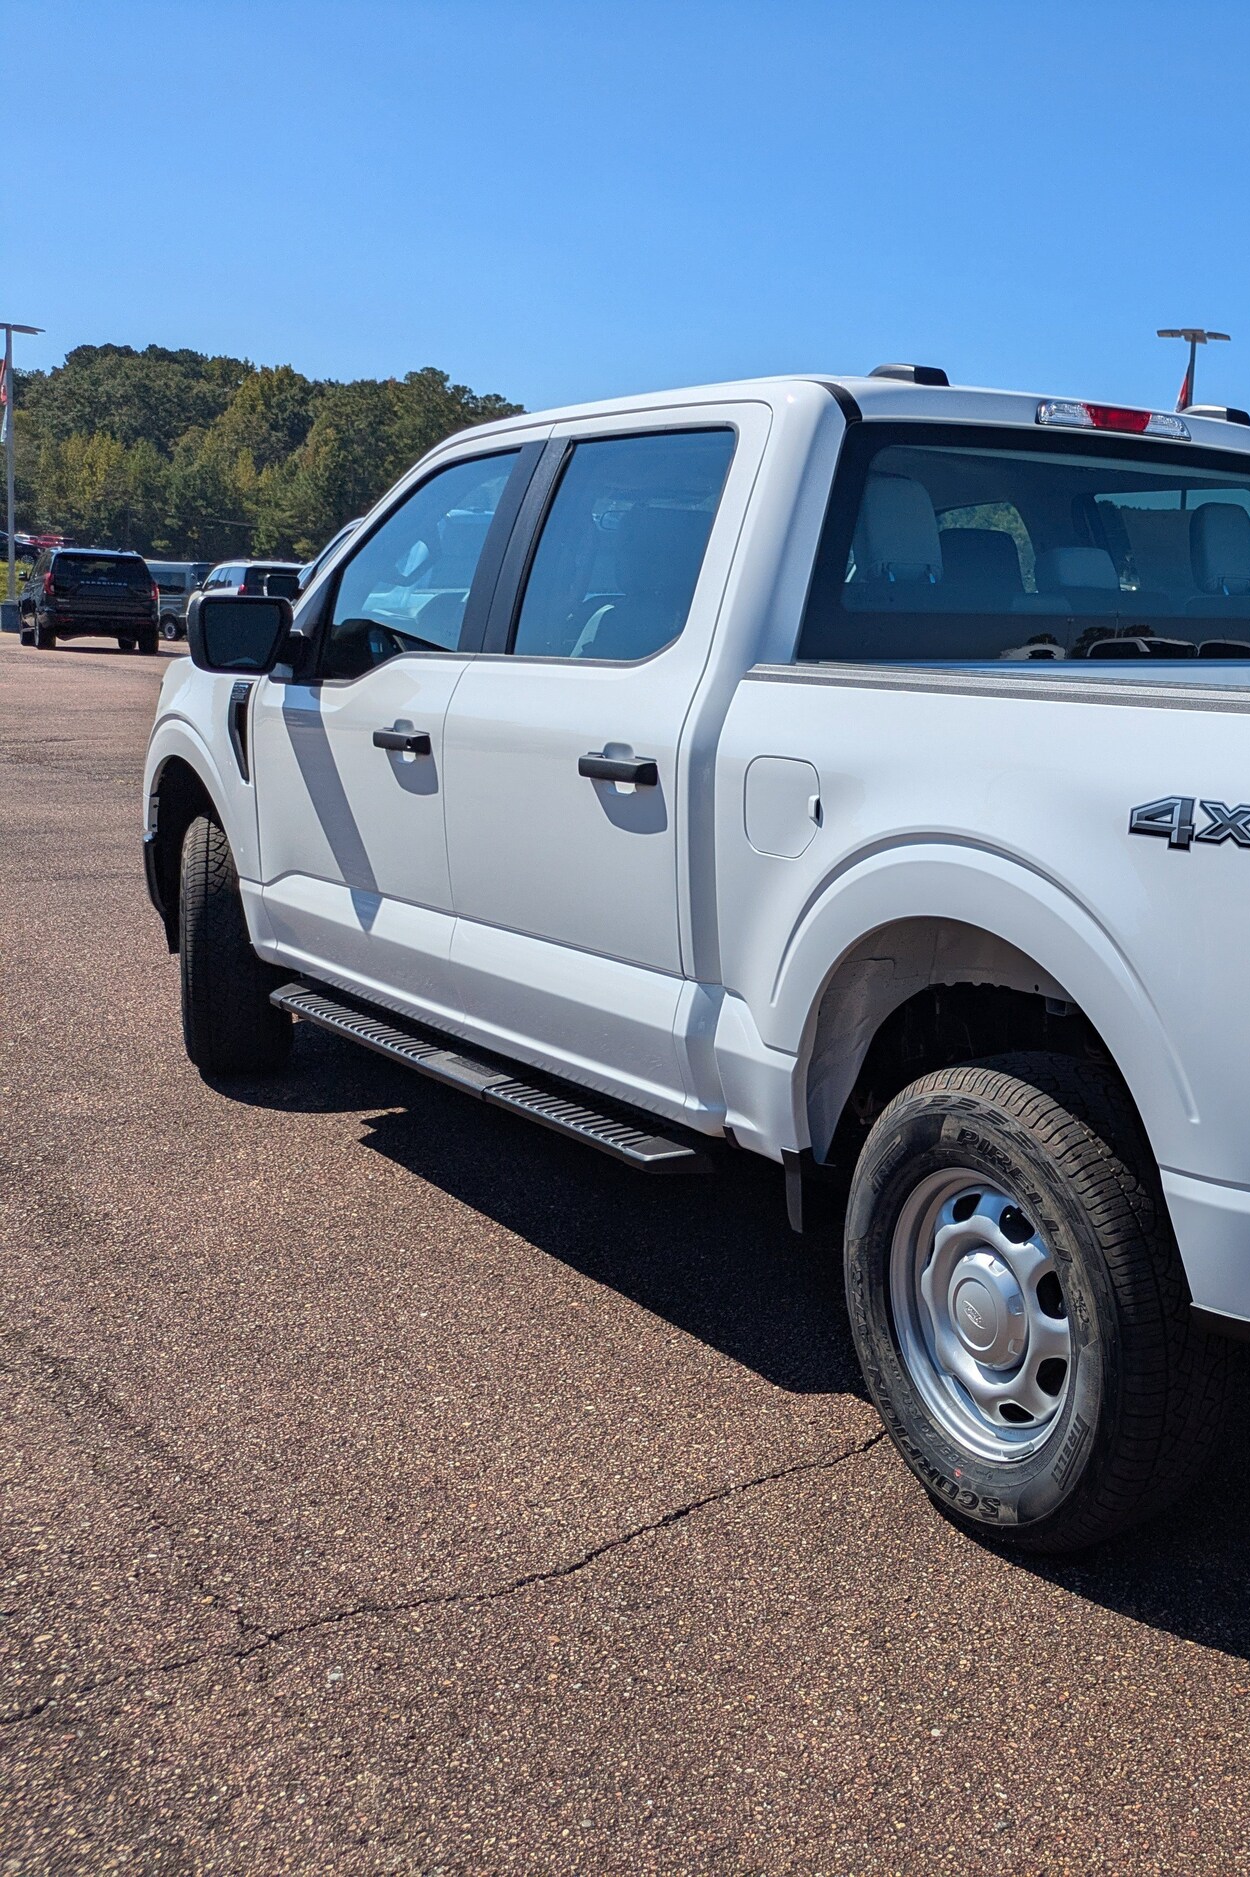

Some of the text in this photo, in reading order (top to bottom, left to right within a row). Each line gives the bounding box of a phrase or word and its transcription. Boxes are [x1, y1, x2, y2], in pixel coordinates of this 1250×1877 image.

[956, 1127, 1074, 1264] PIRELLI
[866, 1366, 1001, 1519] SCORPION
[1051, 1412, 1090, 1491] PIRELLI
